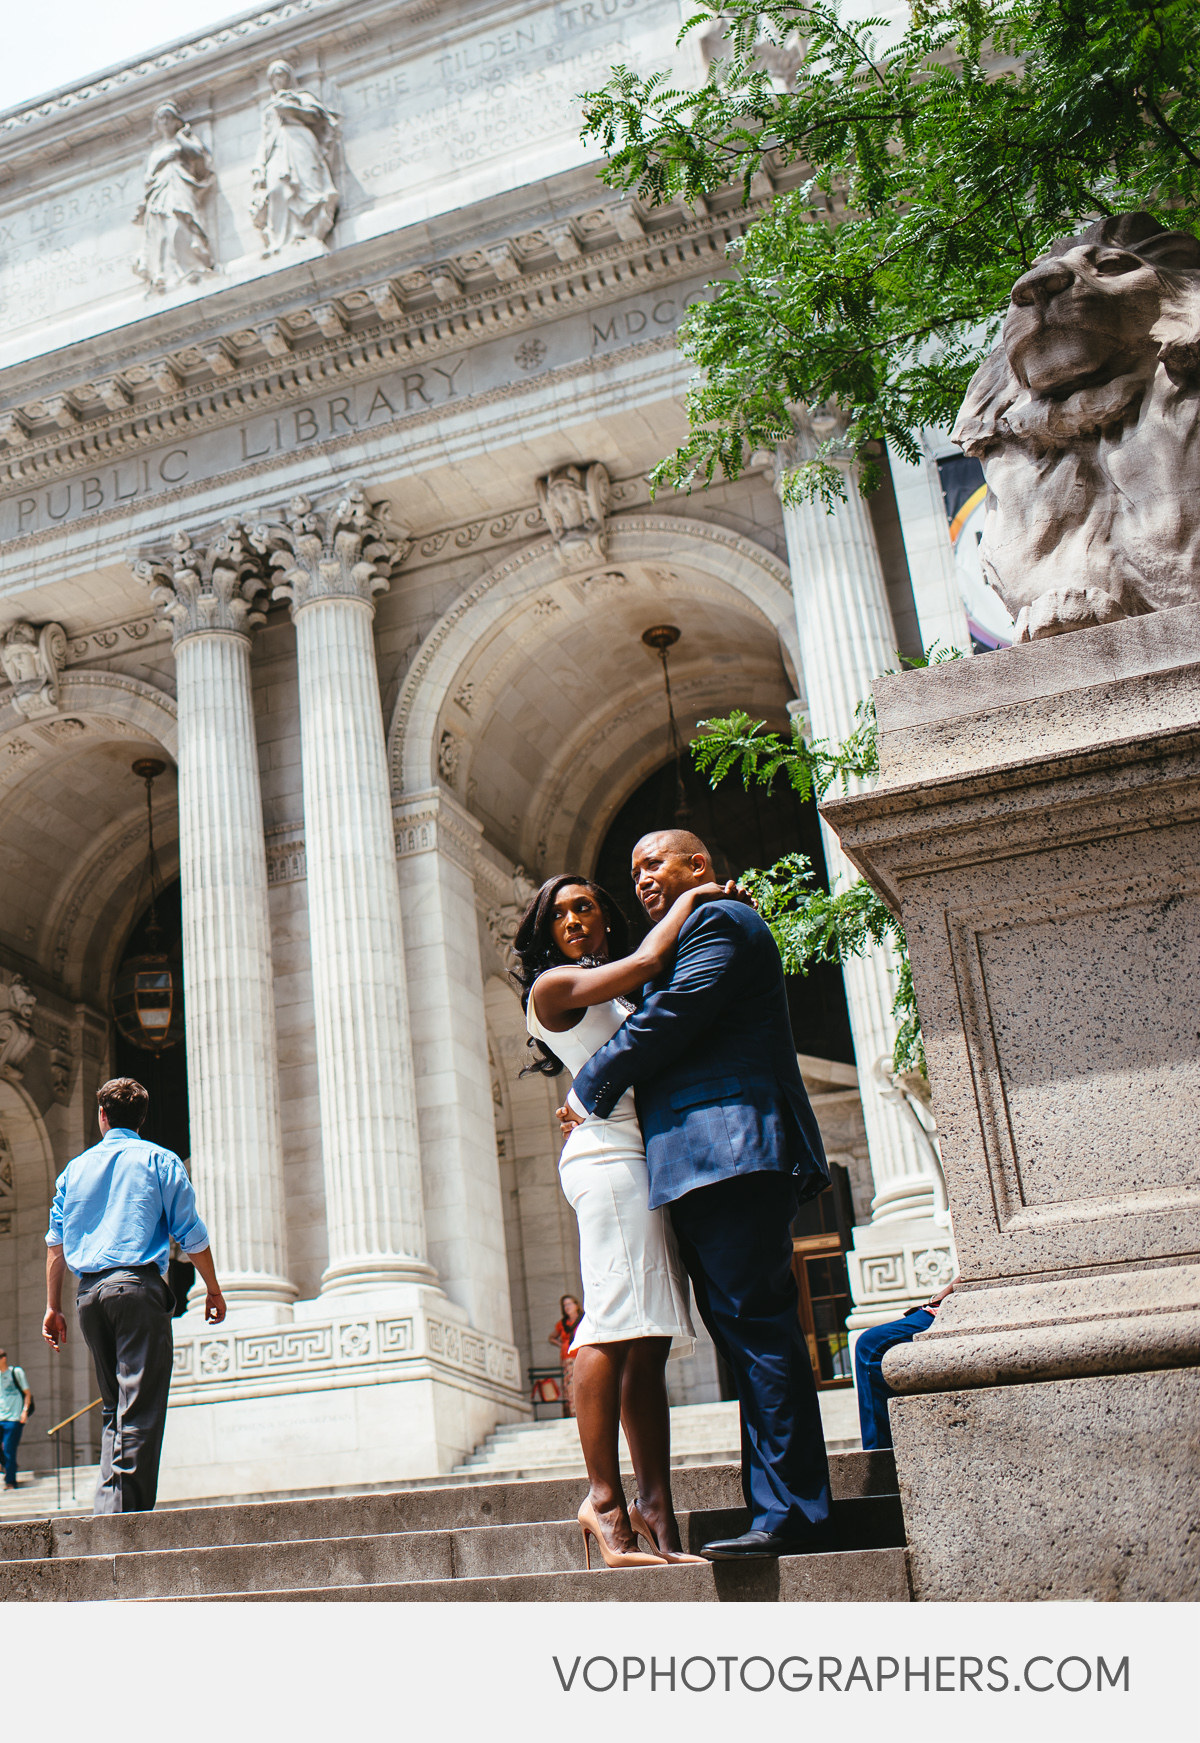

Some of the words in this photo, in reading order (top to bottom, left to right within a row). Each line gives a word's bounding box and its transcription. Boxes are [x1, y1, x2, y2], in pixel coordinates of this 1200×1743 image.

[356, 72, 410, 109] THE
[433, 24, 536, 80] TILDEN
[392, 98, 470, 138] SAMUEL
[480, 67, 547, 104] JONES
[561, 38, 633, 74] TILDEN
[445, 60, 526, 97] FOUNDED
[546, 43, 566, 61] BY
[412, 117, 460, 147] SERVE
[474, 101, 506, 122] THE
[362, 148, 429, 183] SCIENCE
[443, 131, 477, 153] AND
[28, 178, 130, 236] LIBRARY
[11, 246, 75, 279] LENOX
[1, 282, 21, 301] TO
[20, 289, 47, 306] THE
[17, 449, 190, 533] PUBLIC
[240, 357, 466, 462] LIBRARY
